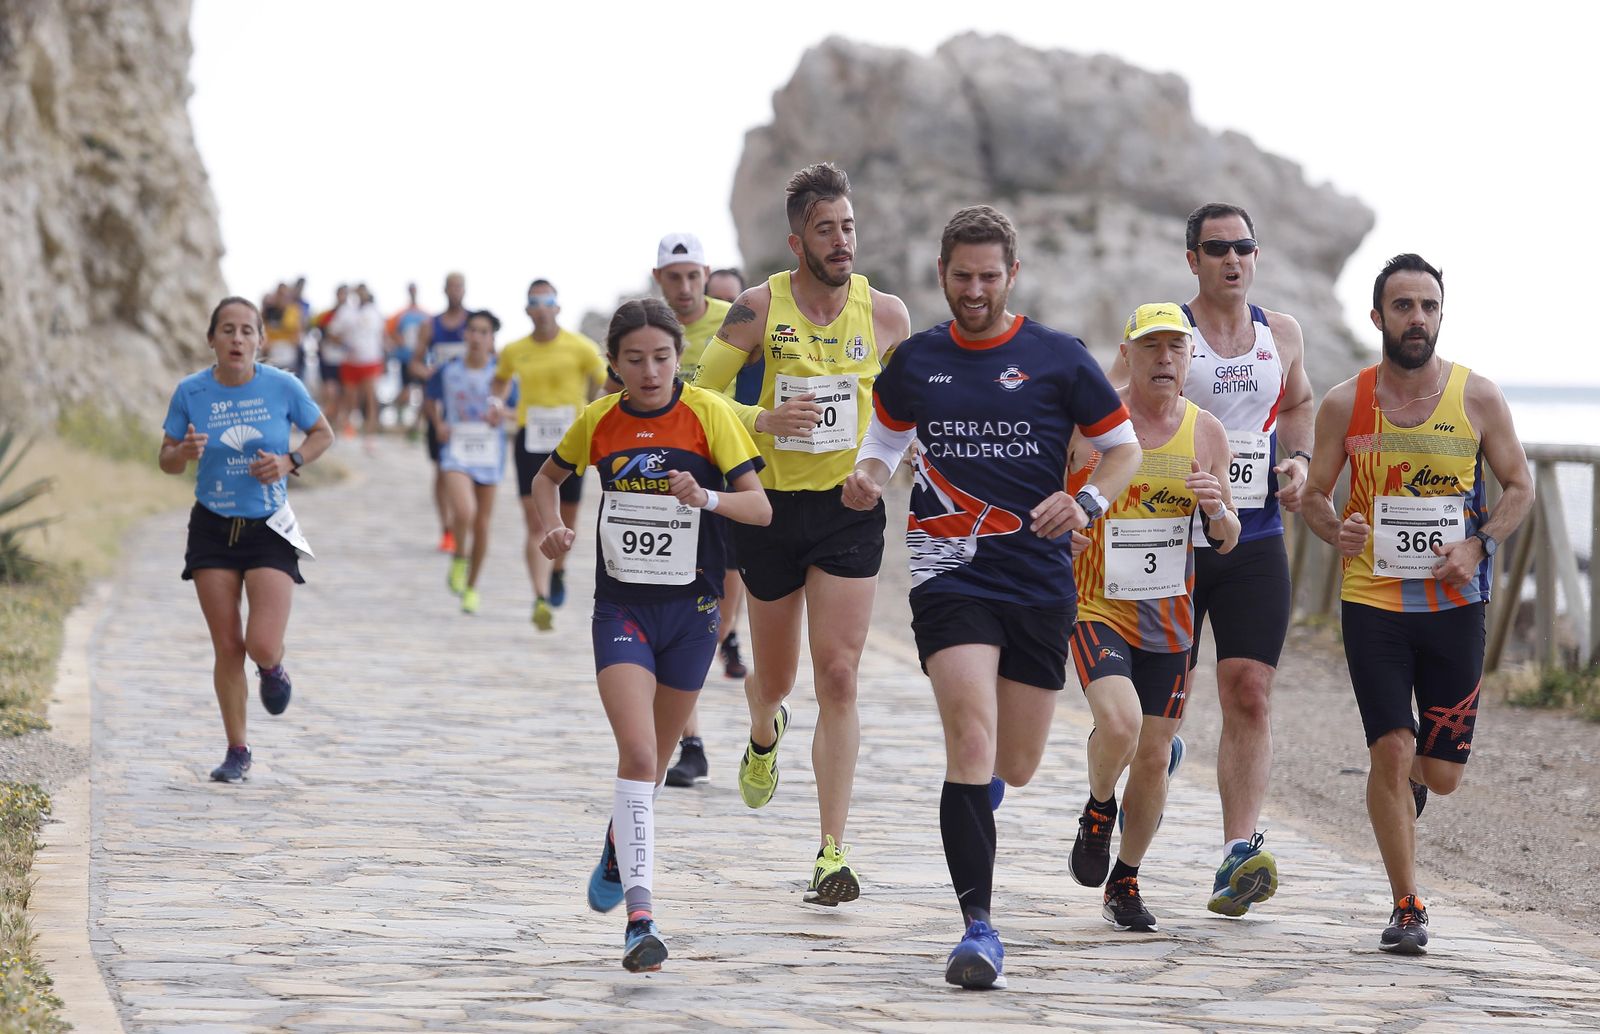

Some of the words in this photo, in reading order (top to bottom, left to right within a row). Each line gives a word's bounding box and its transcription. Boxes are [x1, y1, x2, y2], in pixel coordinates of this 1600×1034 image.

[771, 334, 800, 343] Vopak
[1215, 364, 1254, 379] GREAT
[1213, 379, 1258, 394] BRITAIN
[240, 407, 268, 417] URBANA
[207, 420, 231, 429] CIUDAD
[928, 421, 1031, 436] CERRADO
[929, 438, 1040, 458] CALDERÓN
[1411, 464, 1460, 487] Álora
[614, 477, 670, 492] Málag
[1147, 486, 1192, 507] Álora
[622, 530, 673, 557] 992
[1396, 531, 1443, 553] 366
[1144, 553, 1157, 574] 3
